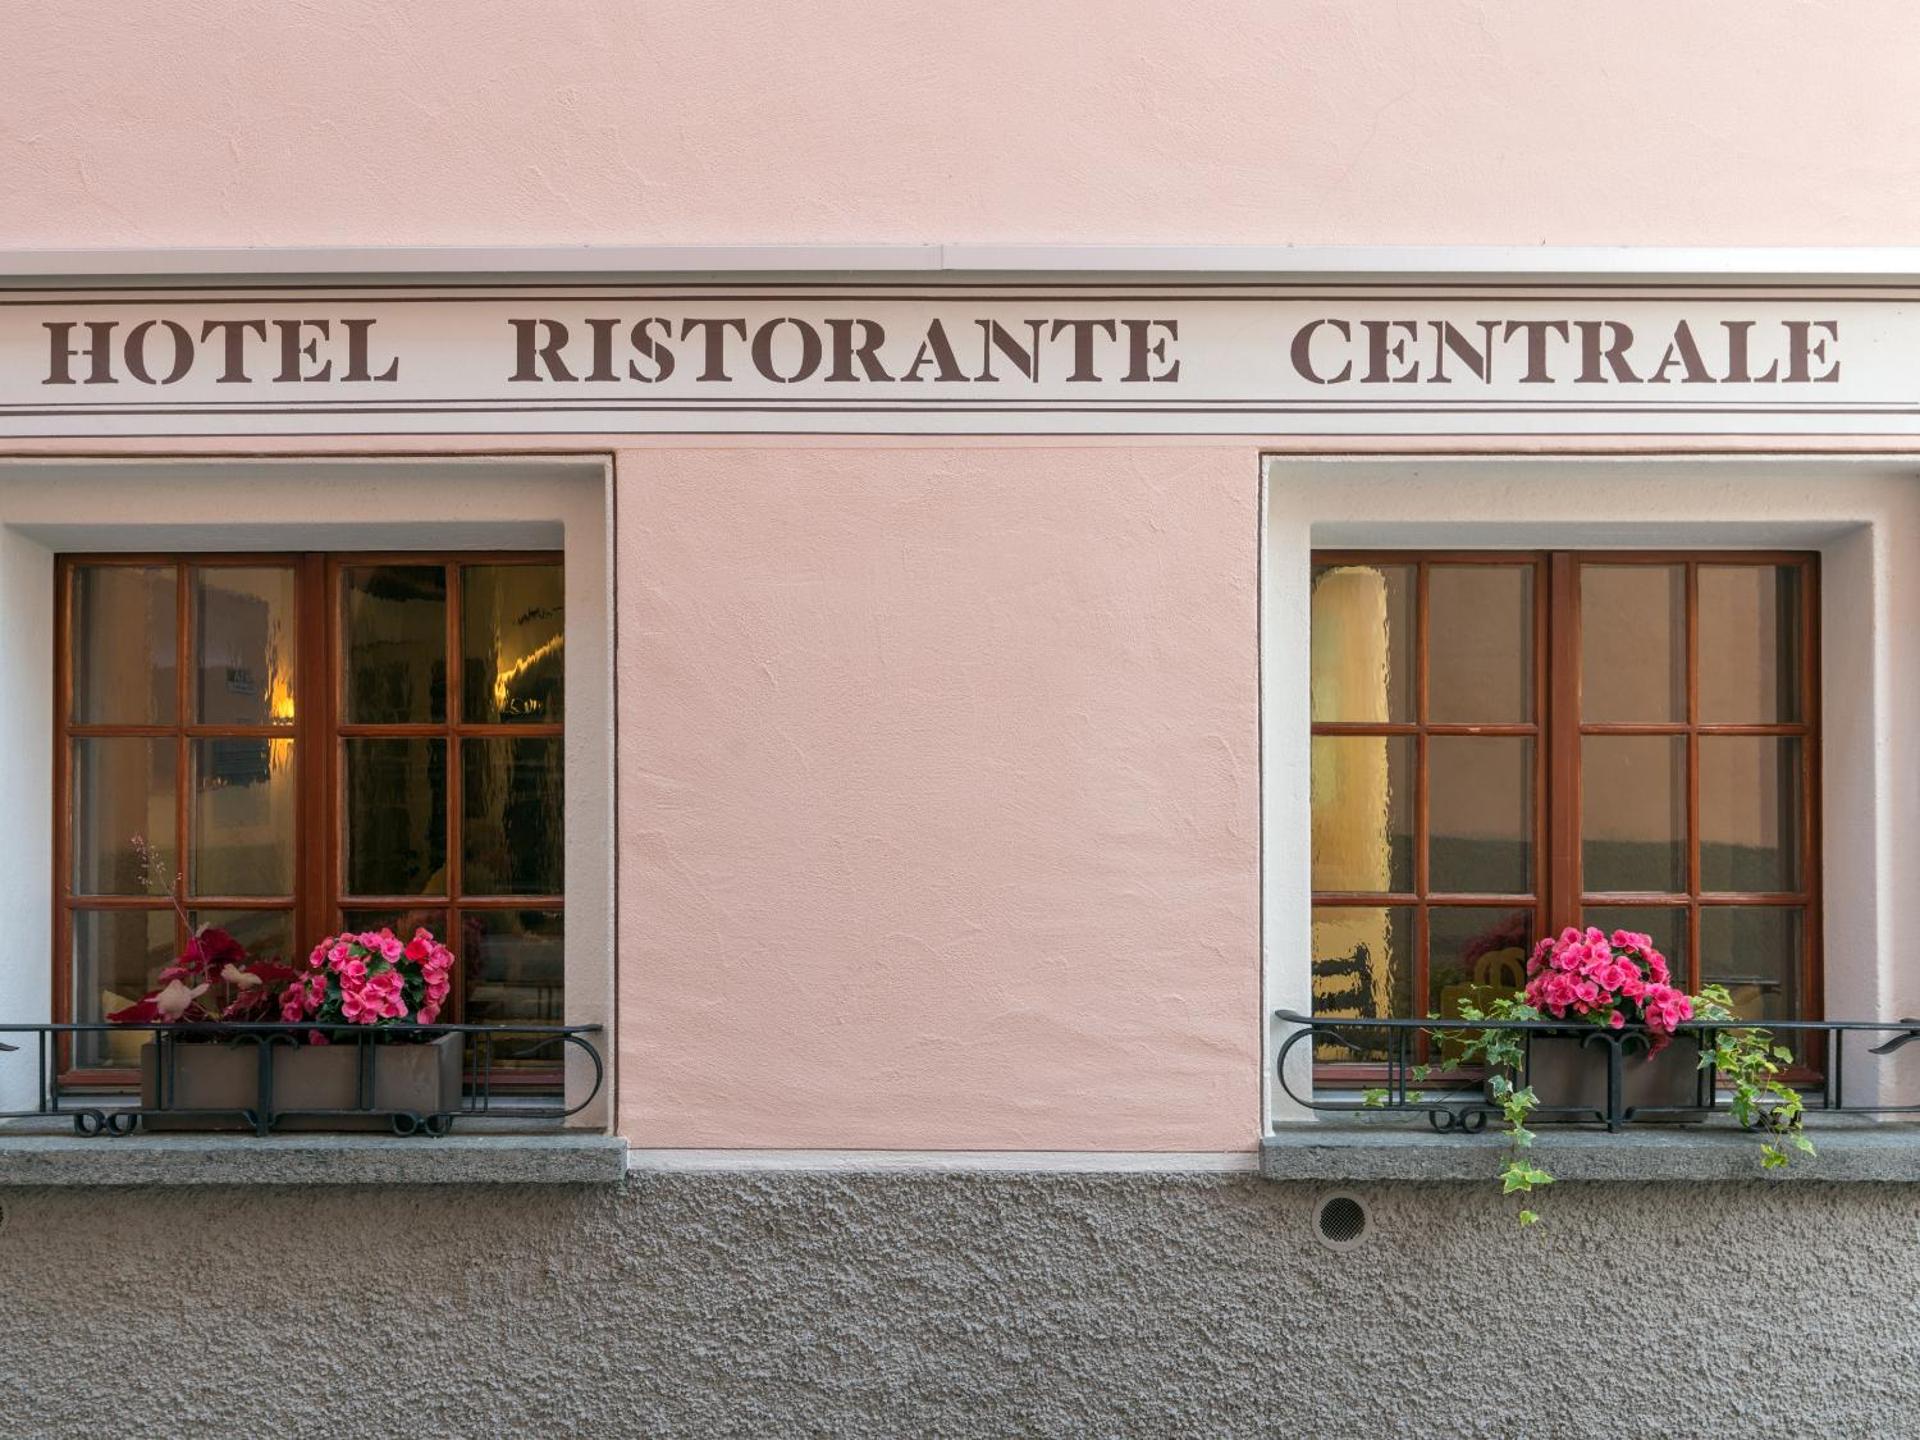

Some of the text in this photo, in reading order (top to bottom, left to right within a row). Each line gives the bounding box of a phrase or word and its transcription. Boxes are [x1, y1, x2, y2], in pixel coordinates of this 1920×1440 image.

[41, 317, 1840, 385] HOTEL RISTORANTE CENTRALE
